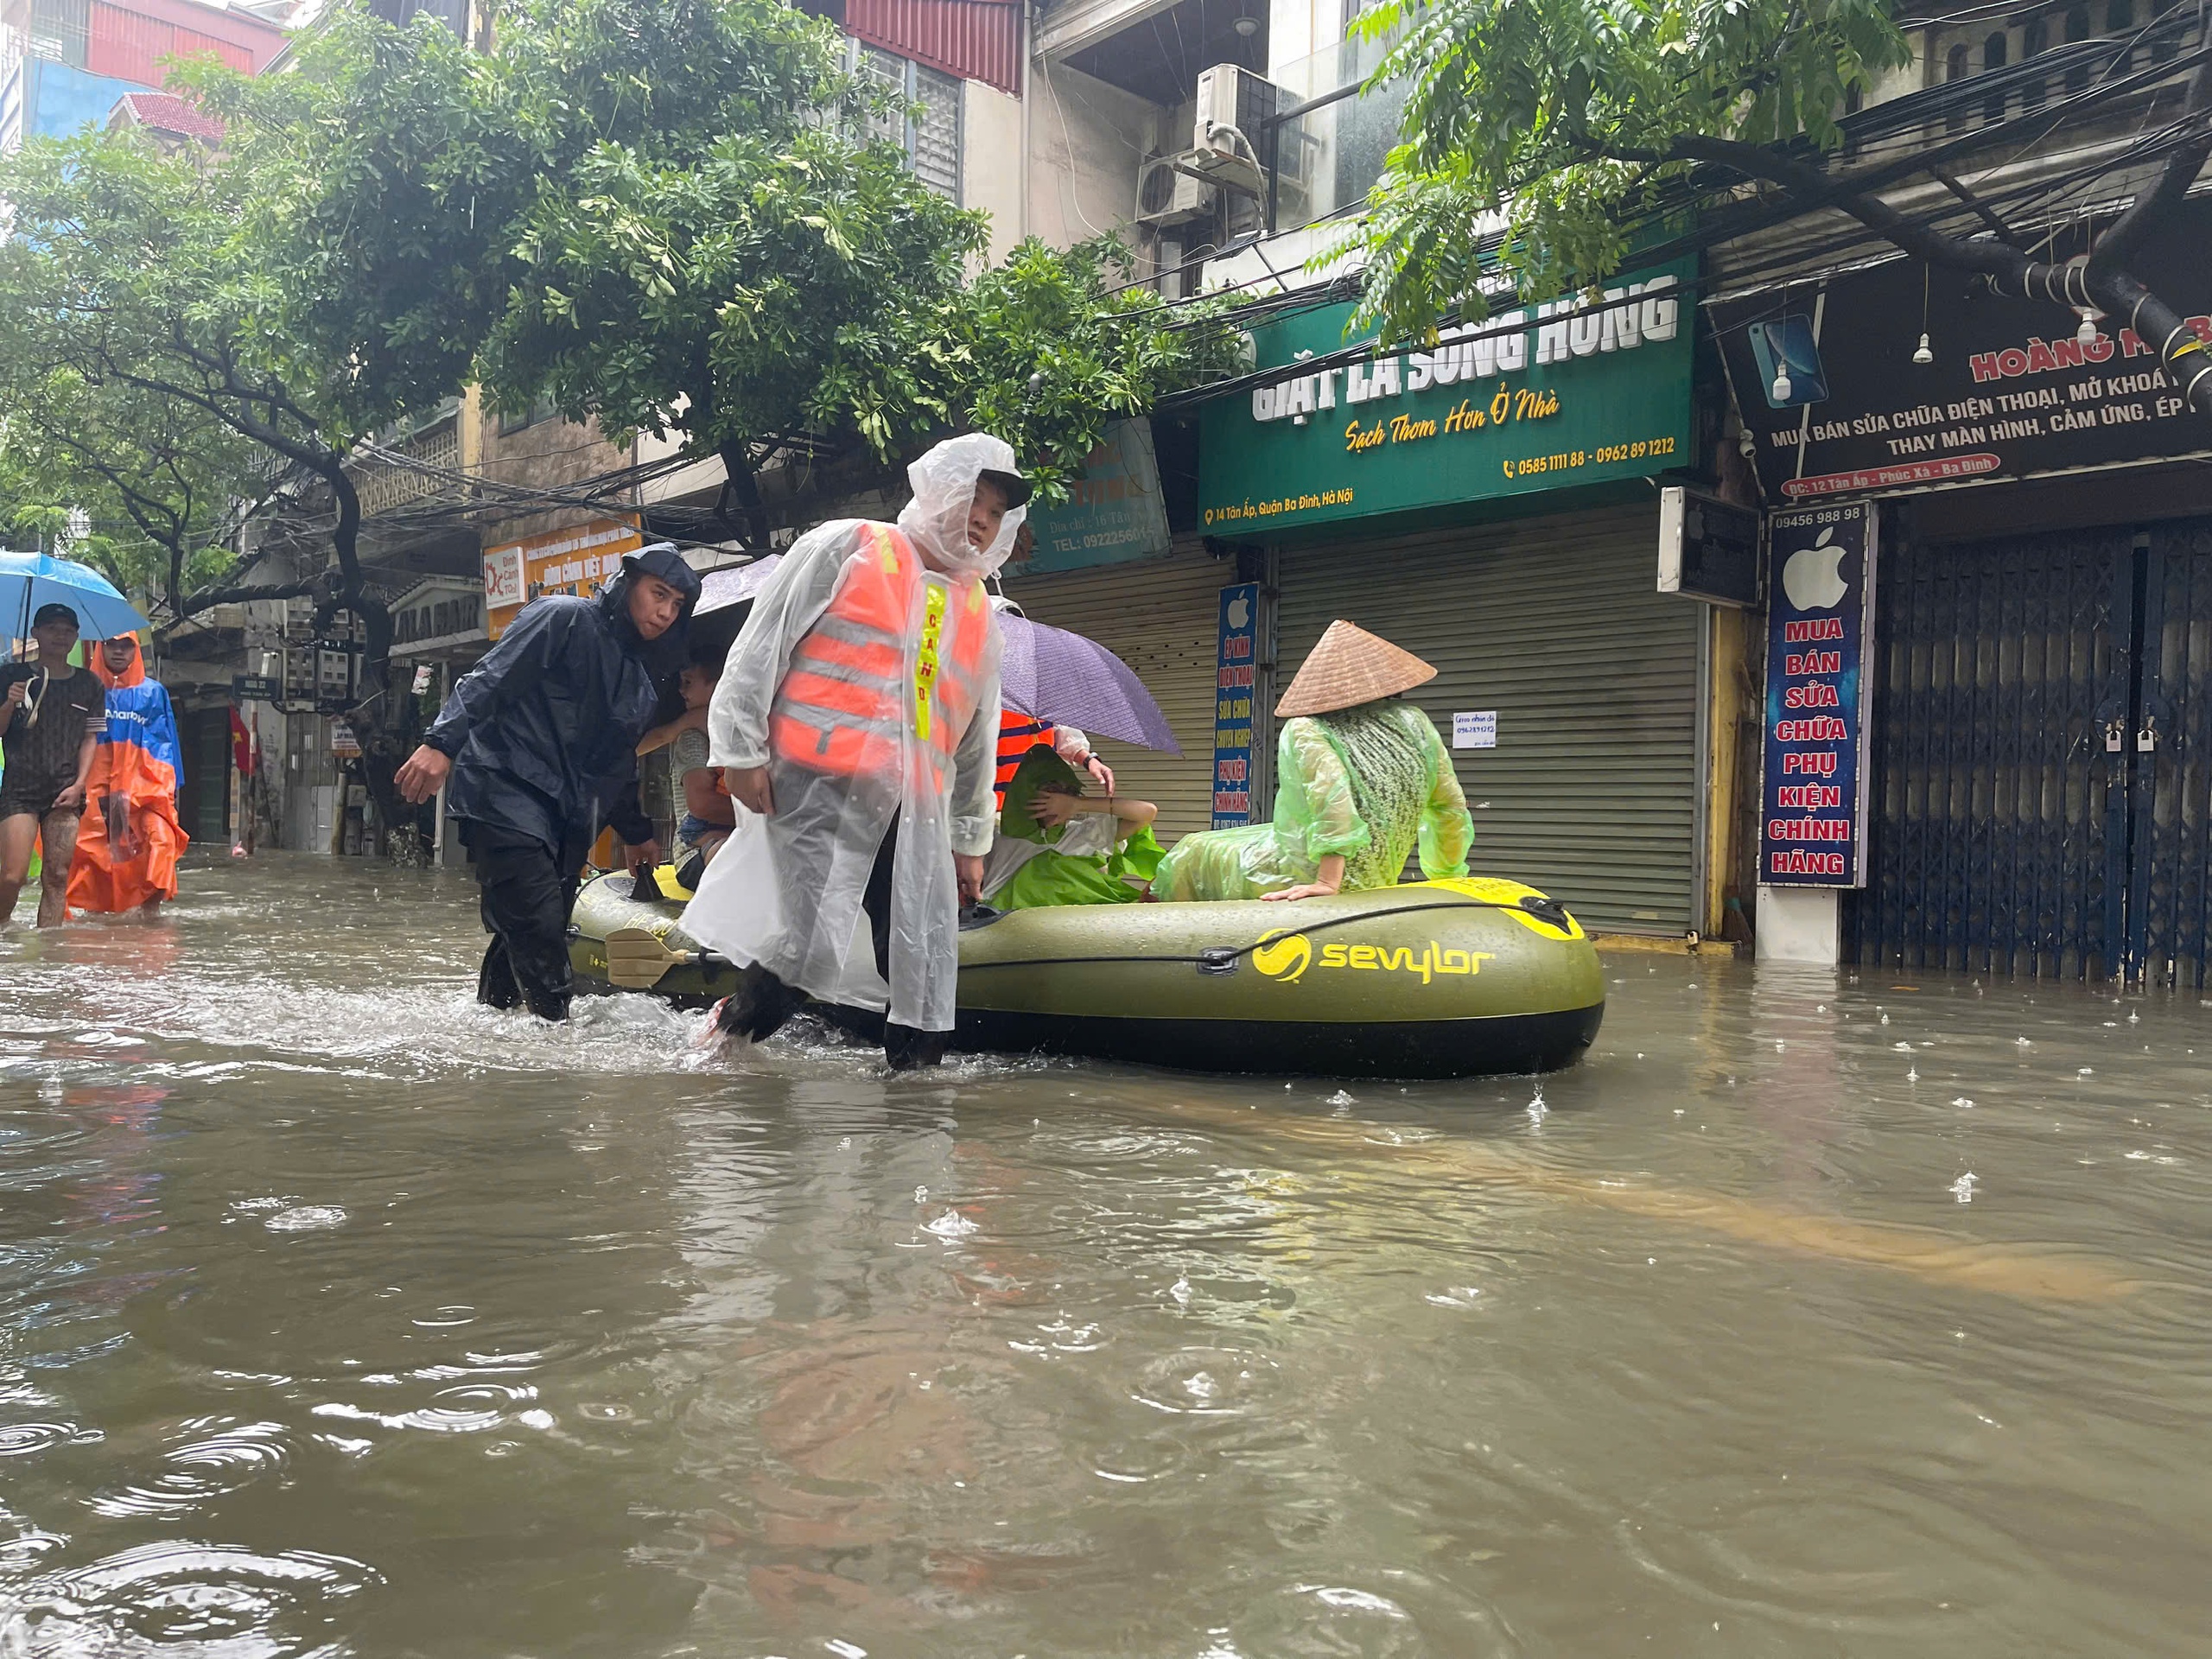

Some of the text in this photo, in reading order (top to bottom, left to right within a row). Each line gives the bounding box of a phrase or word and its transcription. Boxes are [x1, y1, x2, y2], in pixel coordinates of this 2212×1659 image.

[1969, 333, 2115, 383] HOÀNG
[1344, 381, 1560, 454] Sạch Thơm Hơn Ở Nhà
[1771, 428, 1811, 448] MUA
[1813, 420, 1850, 442] BÁN
[1853, 412, 1891, 435] SỬA
[1891, 404, 1945, 428] CHỮA
[1948, 397, 1993, 420] ĐIỆN
[1997, 387, 2065, 412] THOẠI,
[2069, 375, 2102, 403] MỞ
[2107, 367, 2167, 397] KHOÁ
[1886, 434, 1936, 455] THAY
[1940, 426, 1986, 448] MÀN
[1990, 415, 2046, 441] HÌNH,
[2050, 407, 2097, 433] CẢM
[2100, 403, 2151, 426] ỨNG,
[2156, 396, 2184, 418] ÉP
[1518, 457, 1547, 475] 0585
[1548, 453, 1567, 471] 1111
[1570, 450, 1585, 467] 88
[1596, 444, 1628, 464] 0962
[1630, 442, 1646, 459] 89
[1649, 436, 1675, 456] 1212
[1811, 480, 1827, 493] 12
[1828, 477, 1850, 491] Tân
[1879, 470, 1911, 484] Phúc
[1942, 462, 1960, 475] Ba
[1215, 487, 1354, 522] 14 Tân Ấp, Quận Ba Đình, Hà Nội
[1775, 506, 1860, 529] 09456 988 98
[1052, 537, 1083, 552] TEL:
[1784, 617, 1845, 643] MUA
[1785, 649, 1840, 676] BÁN
[1785, 679, 1840, 709] SỬA
[1776, 715, 1848, 742] CHỮA
[1783, 752, 1837, 779] PHỤ
[1778, 781, 1840, 811] KIỆN
[1768, 816, 1850, 842] CHÍNH
[1771, 849, 1845, 874] HÃNG
[1318, 940, 1496, 985] sevylor
